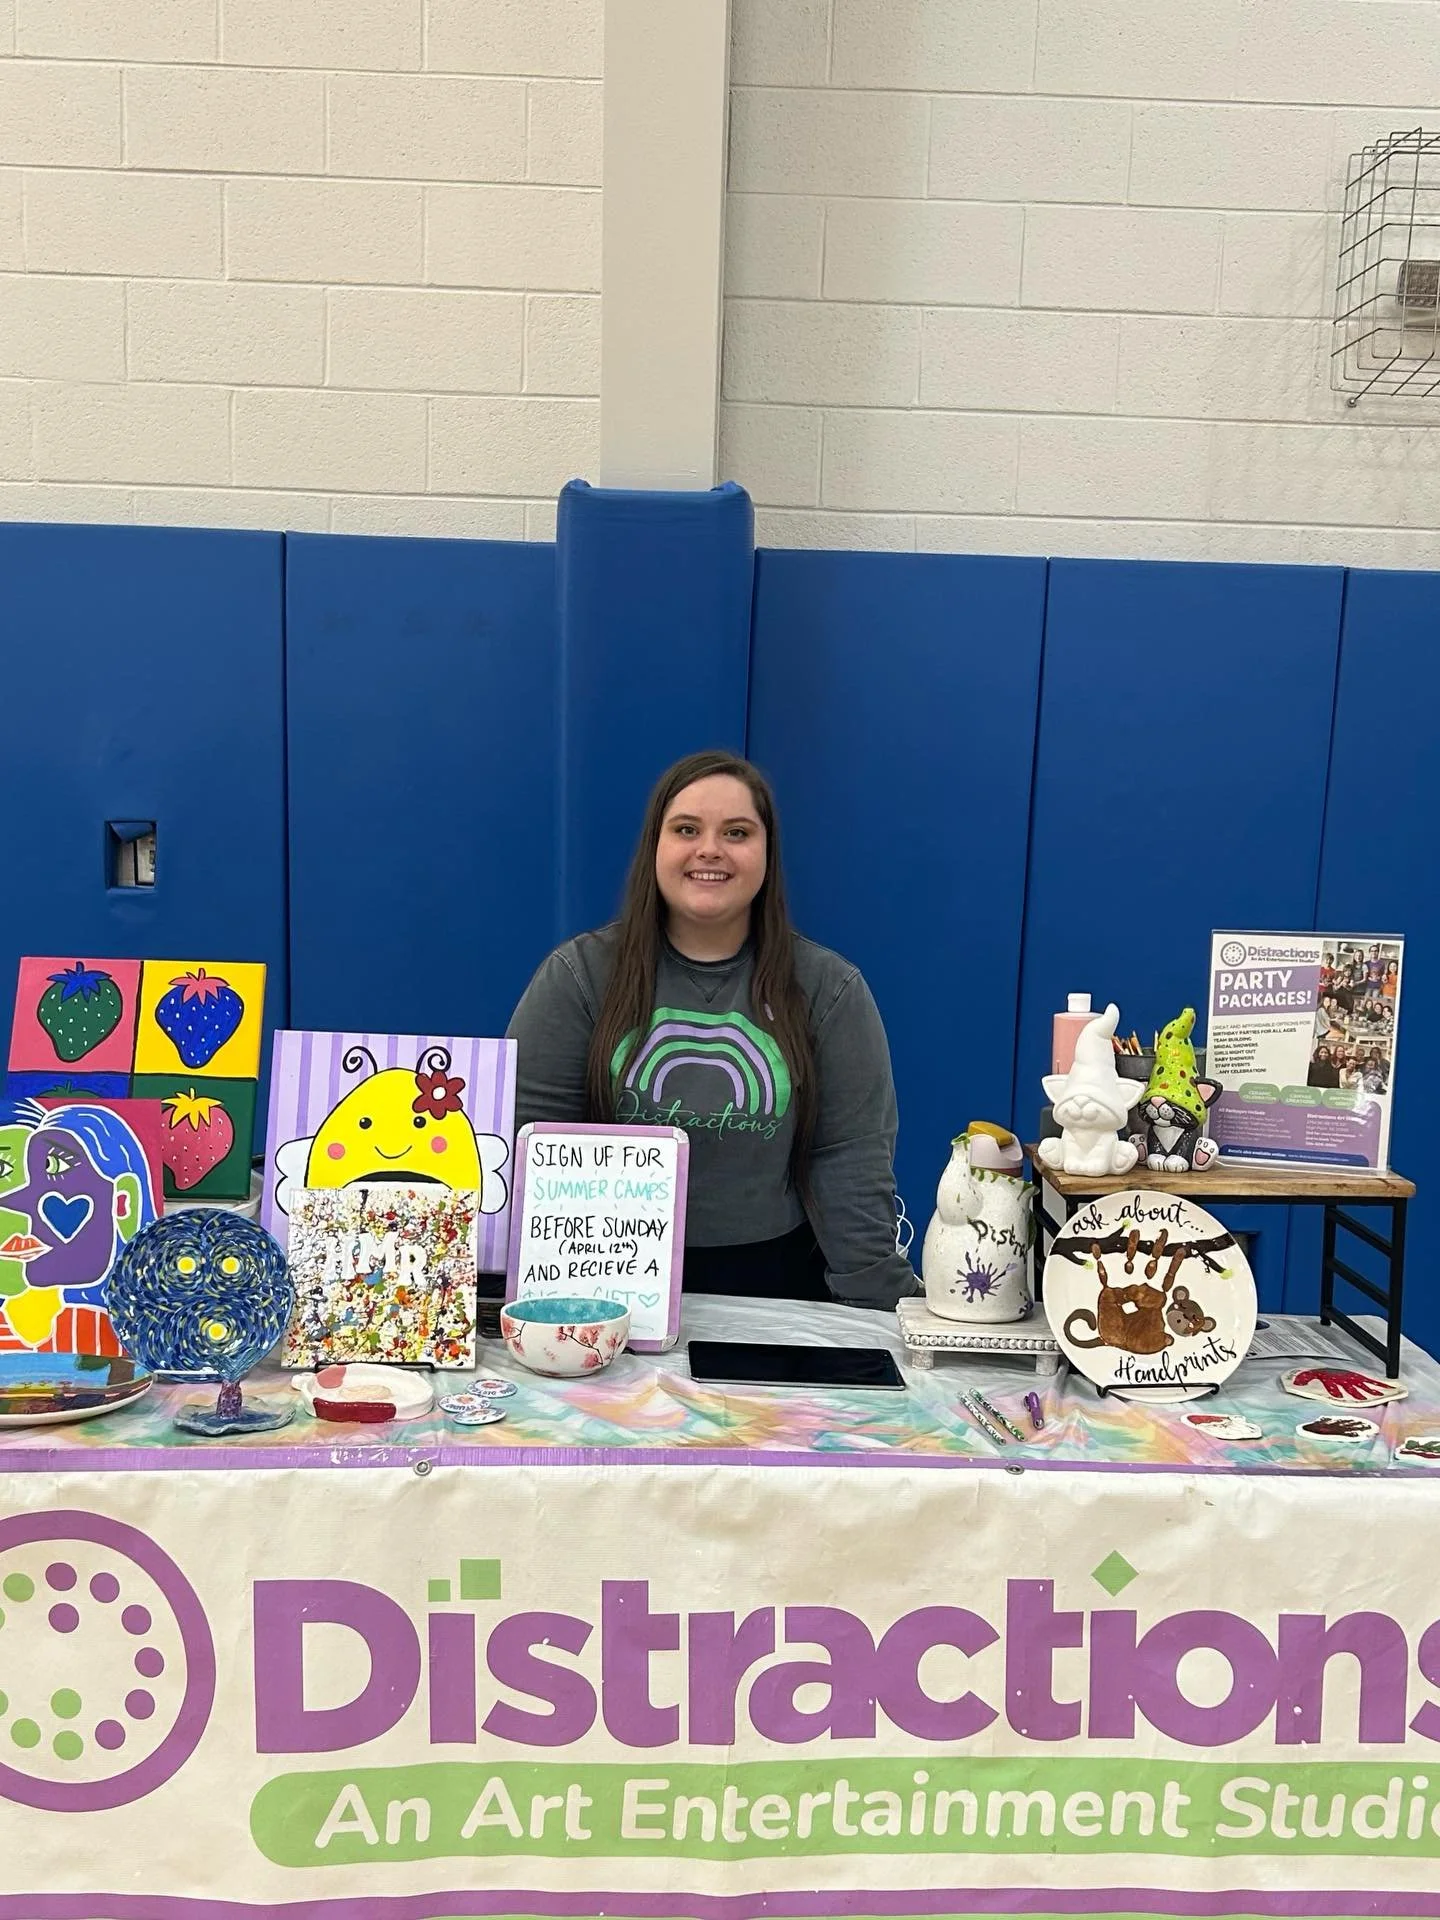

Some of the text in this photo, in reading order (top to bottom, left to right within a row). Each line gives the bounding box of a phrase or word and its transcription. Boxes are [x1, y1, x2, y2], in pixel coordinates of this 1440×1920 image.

[1247, 946, 1320, 959] Distractions
[1220, 969, 1293, 991] PARTY
[1219, 990, 1312, 1009] PACKAGES!
[615, 1089, 783, 1141] Distractions
[532, 1142, 583, 1168] SIGN
[623, 1145, 665, 1168] FOR
[533, 1176, 670, 1201] SUMMER CAMPS
[530, 1215, 669, 1241] BEFORE SUNDAY
[1072, 1203, 1110, 1235] ask
[524, 1258, 660, 1283] AND RECIEVE A
[1114, 1336, 1237, 1392] Handprints
[253, 1549, 1440, 1754] Distraction
[314, 1770, 1440, 1849] An Art Entertainment Studi
